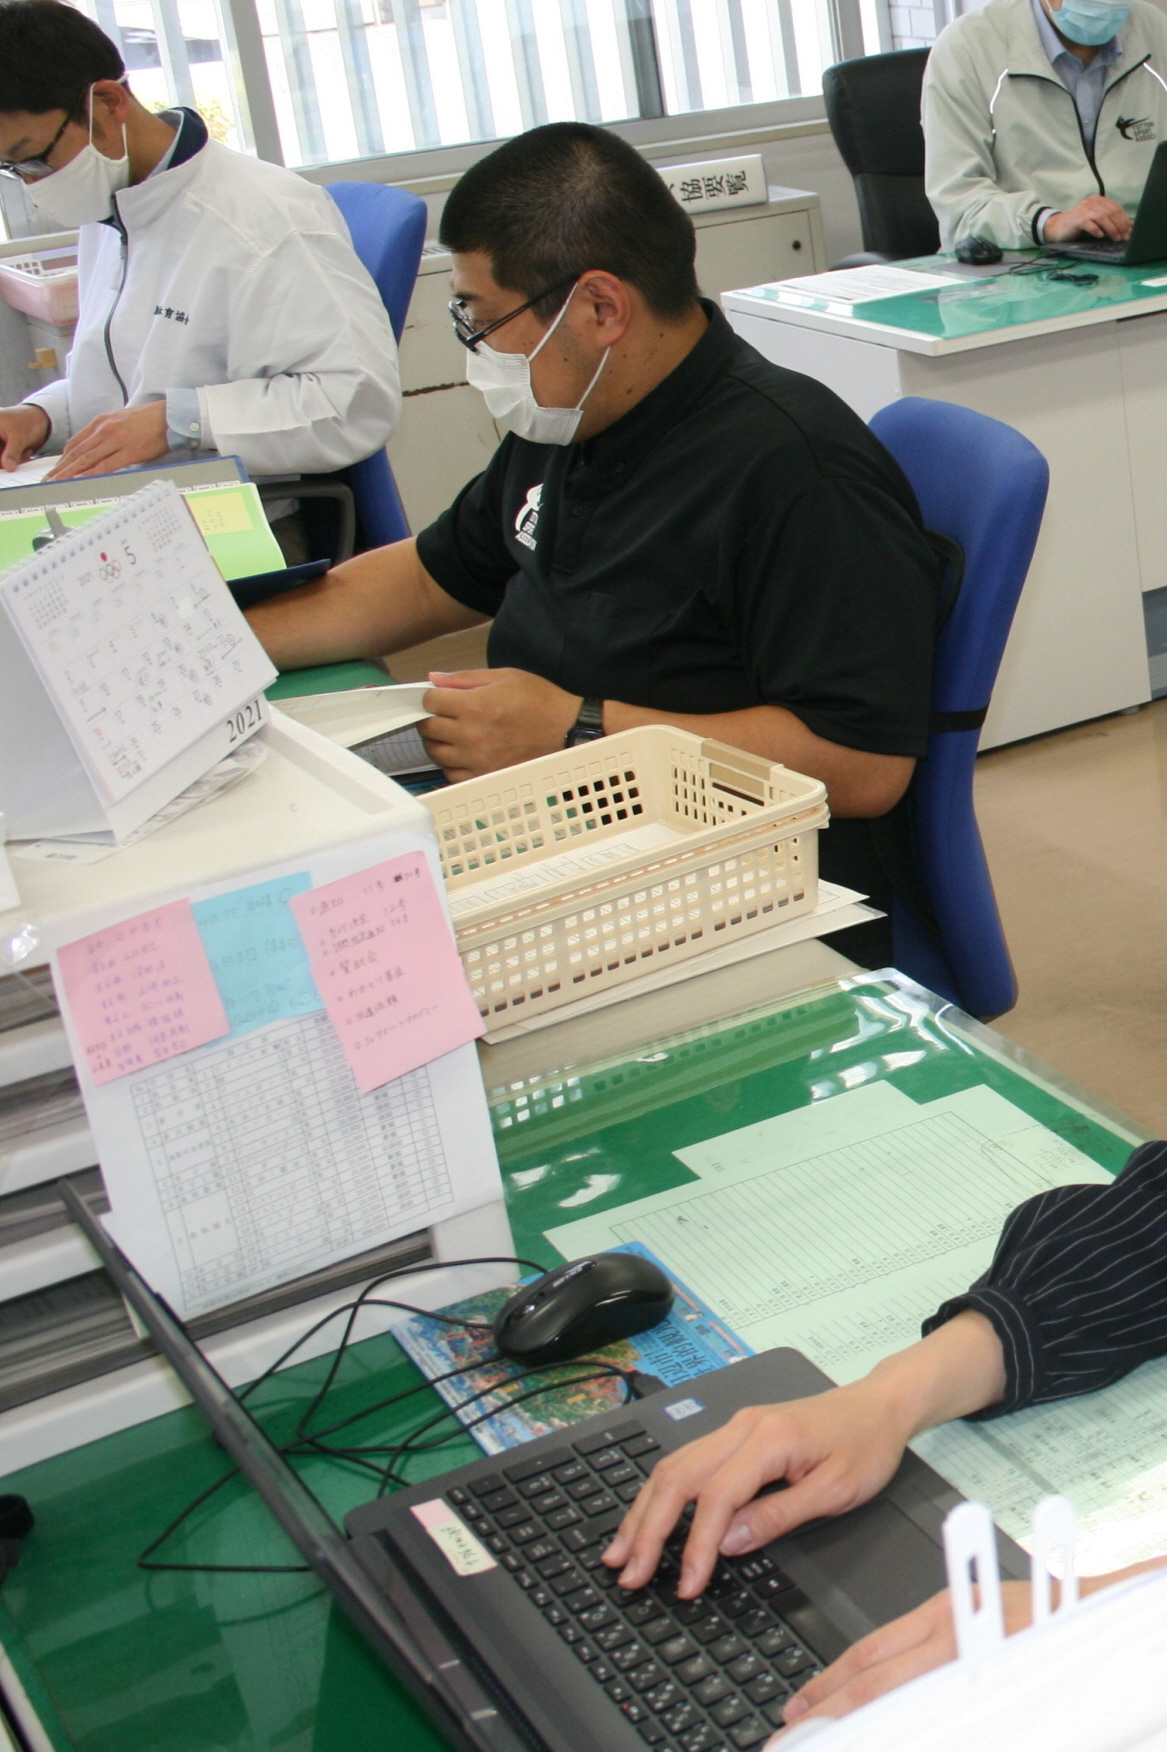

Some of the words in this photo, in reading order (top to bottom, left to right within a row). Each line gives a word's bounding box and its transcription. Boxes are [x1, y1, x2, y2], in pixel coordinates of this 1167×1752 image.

[667, 169, 750, 204] 協要覧
[123, 545, 137, 566] 5
[226, 699, 264, 744] 2021
